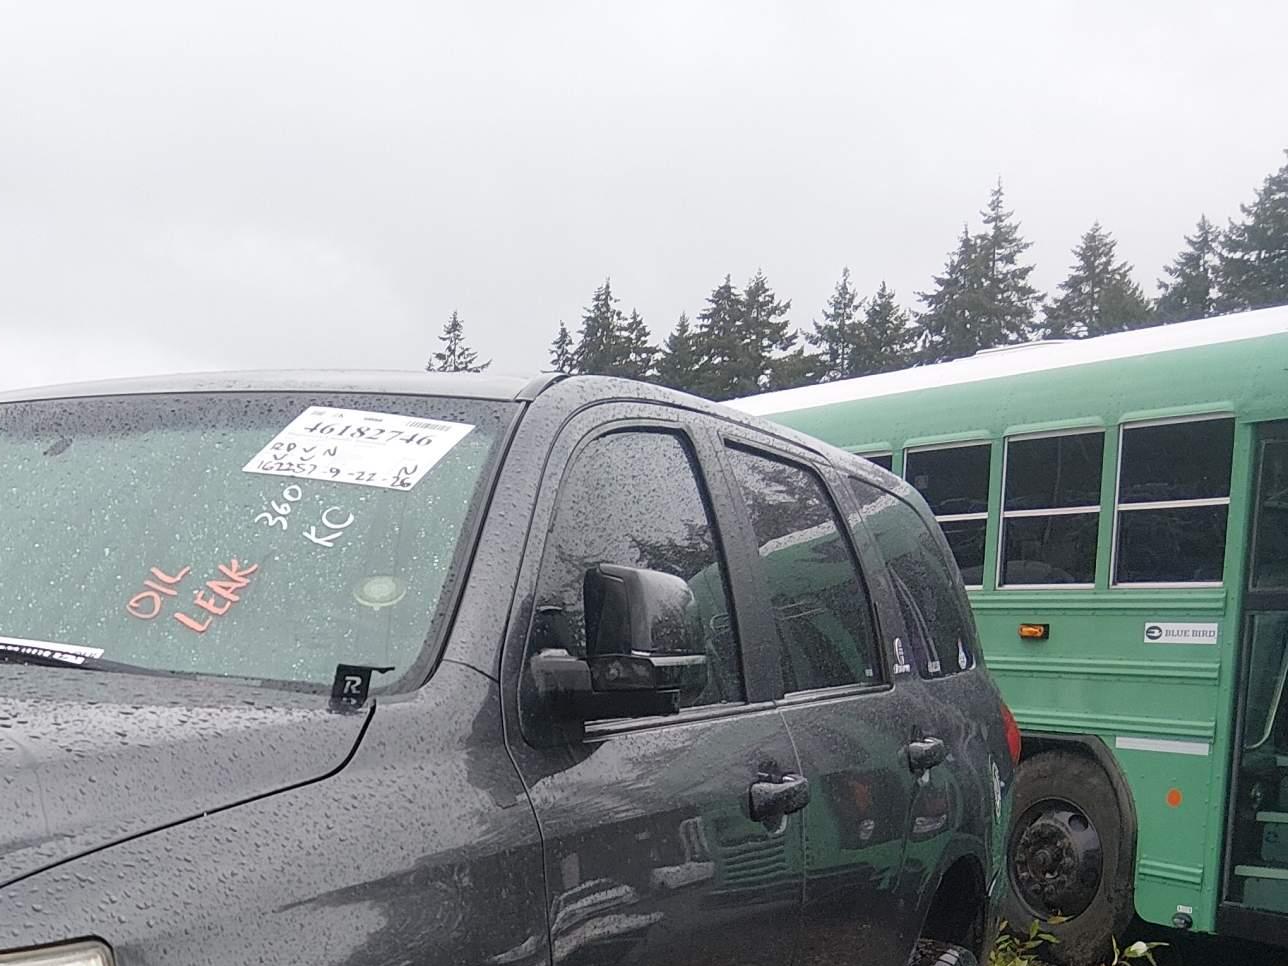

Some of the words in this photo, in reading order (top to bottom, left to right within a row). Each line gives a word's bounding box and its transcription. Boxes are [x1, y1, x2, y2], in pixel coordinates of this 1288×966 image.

[303, 421, 433, 447] 46182746
[255, 484, 303, 530] 360
[302, 506, 354, 547] KC
[125, 565, 191, 619] OIL
[173, 558, 259, 633] LEAK
[1164, 629, 1190, 638] BLUE
[1191, 629, 1216, 638] BIRD
